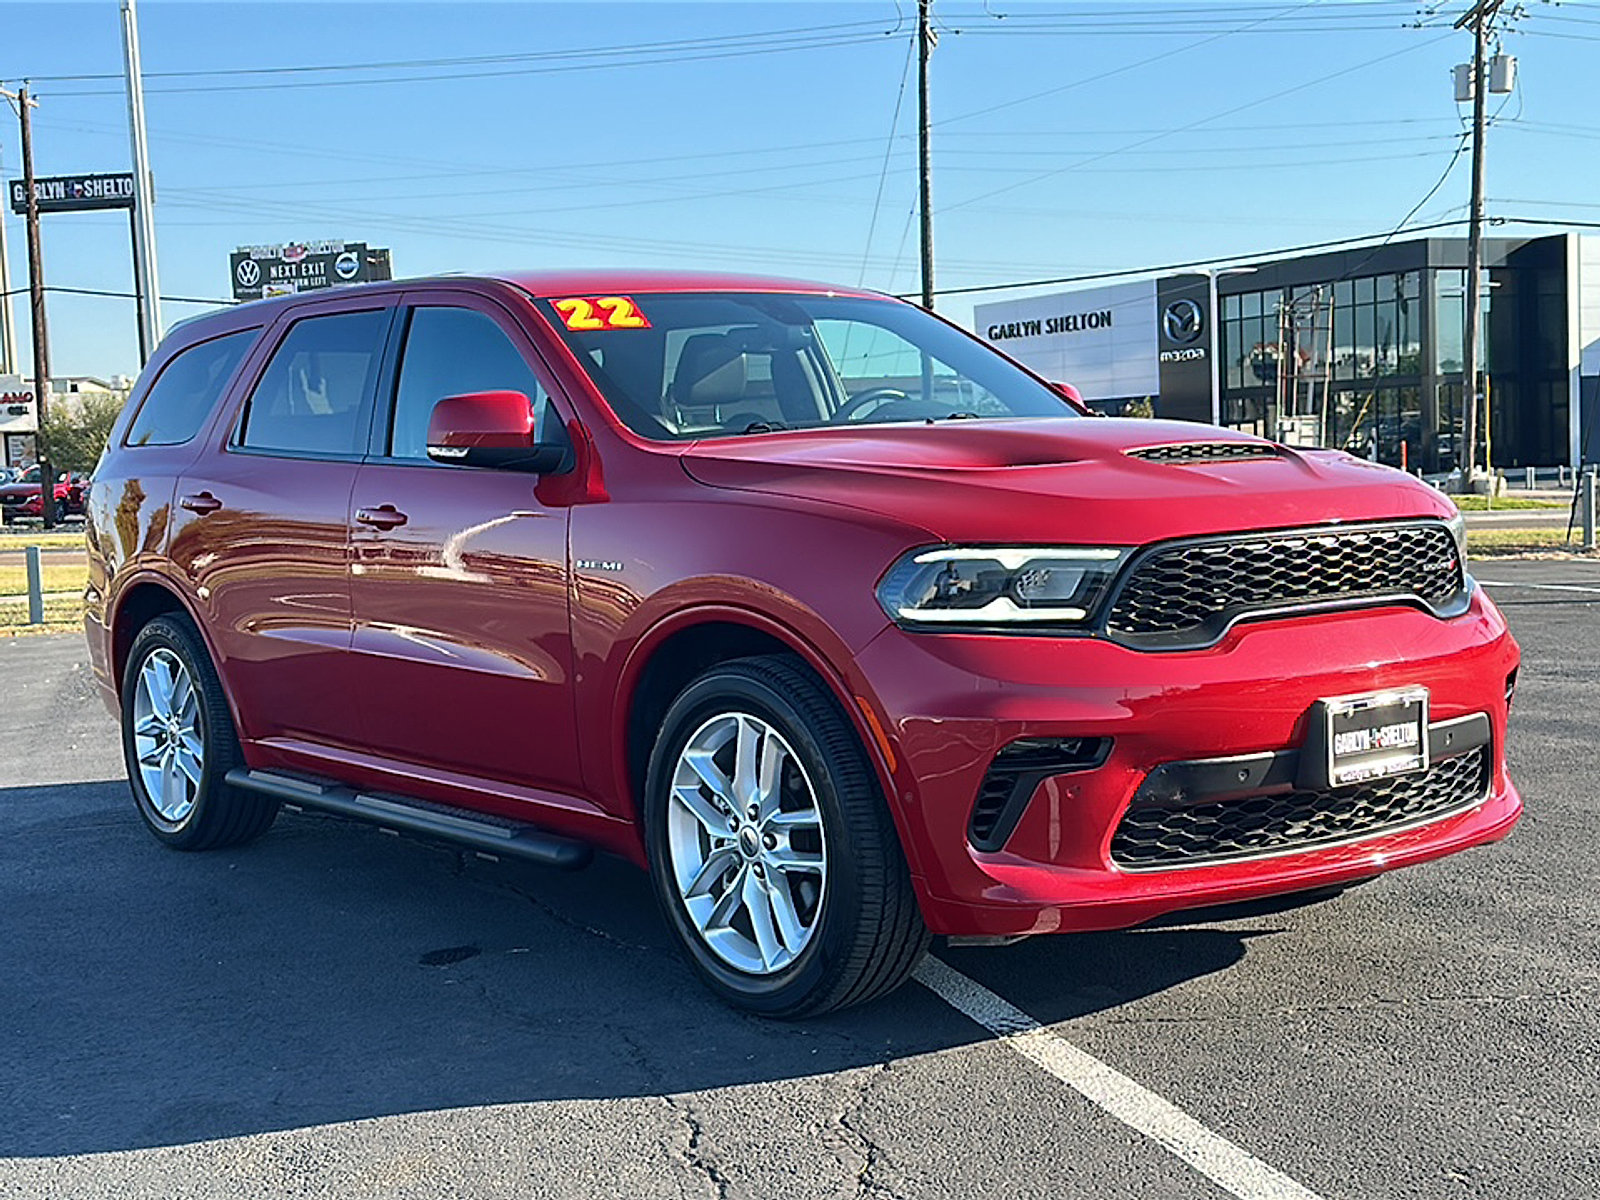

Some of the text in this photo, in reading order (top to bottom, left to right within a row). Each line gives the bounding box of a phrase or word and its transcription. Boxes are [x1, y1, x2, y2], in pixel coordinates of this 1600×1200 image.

[14, 178, 133, 201] GRLYN SHELTO
[270, 264, 297, 278] NEXT
[301, 262, 325, 276] EXIT
[556, 297, 644, 328] 22
[988, 310, 1112, 341] GARLYN SHELTON
[576, 559, 624, 571] HEMI
